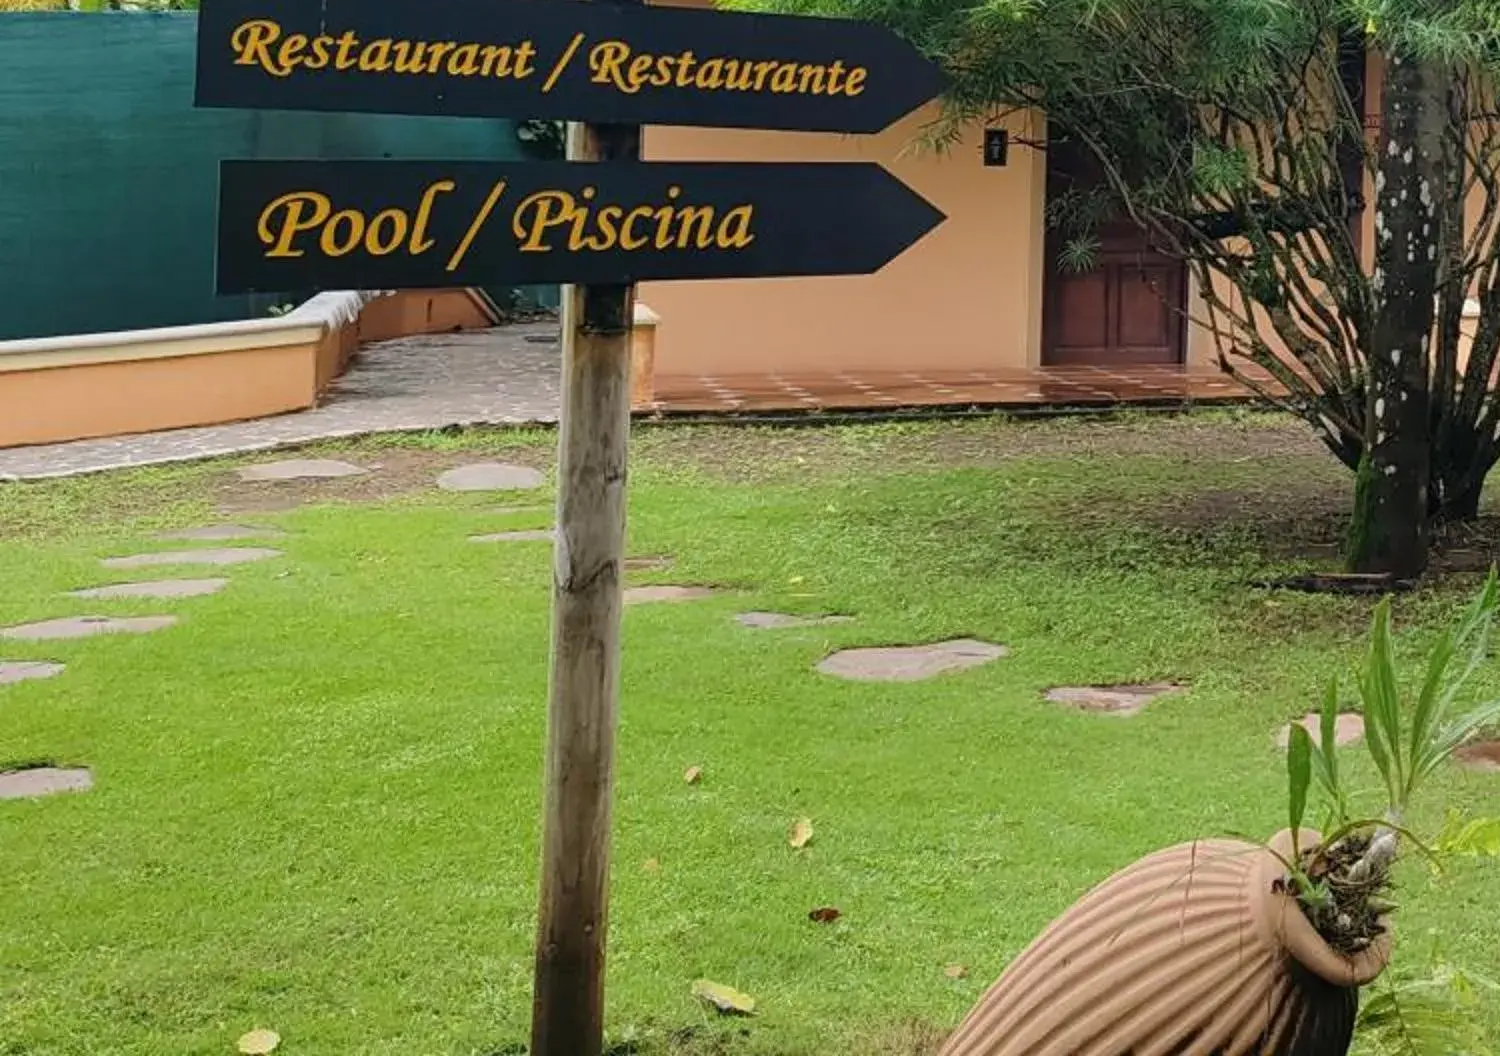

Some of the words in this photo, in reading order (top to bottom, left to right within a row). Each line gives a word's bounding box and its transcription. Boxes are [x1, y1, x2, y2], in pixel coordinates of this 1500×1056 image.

[231, 19, 536, 77] Restaurant
[541, 34, 584, 93] /
[589, 41, 868, 97] Restaurante
[256, 180, 455, 258] Pool
[446, 182, 506, 270] /
[512, 186, 755, 253] Piscina
